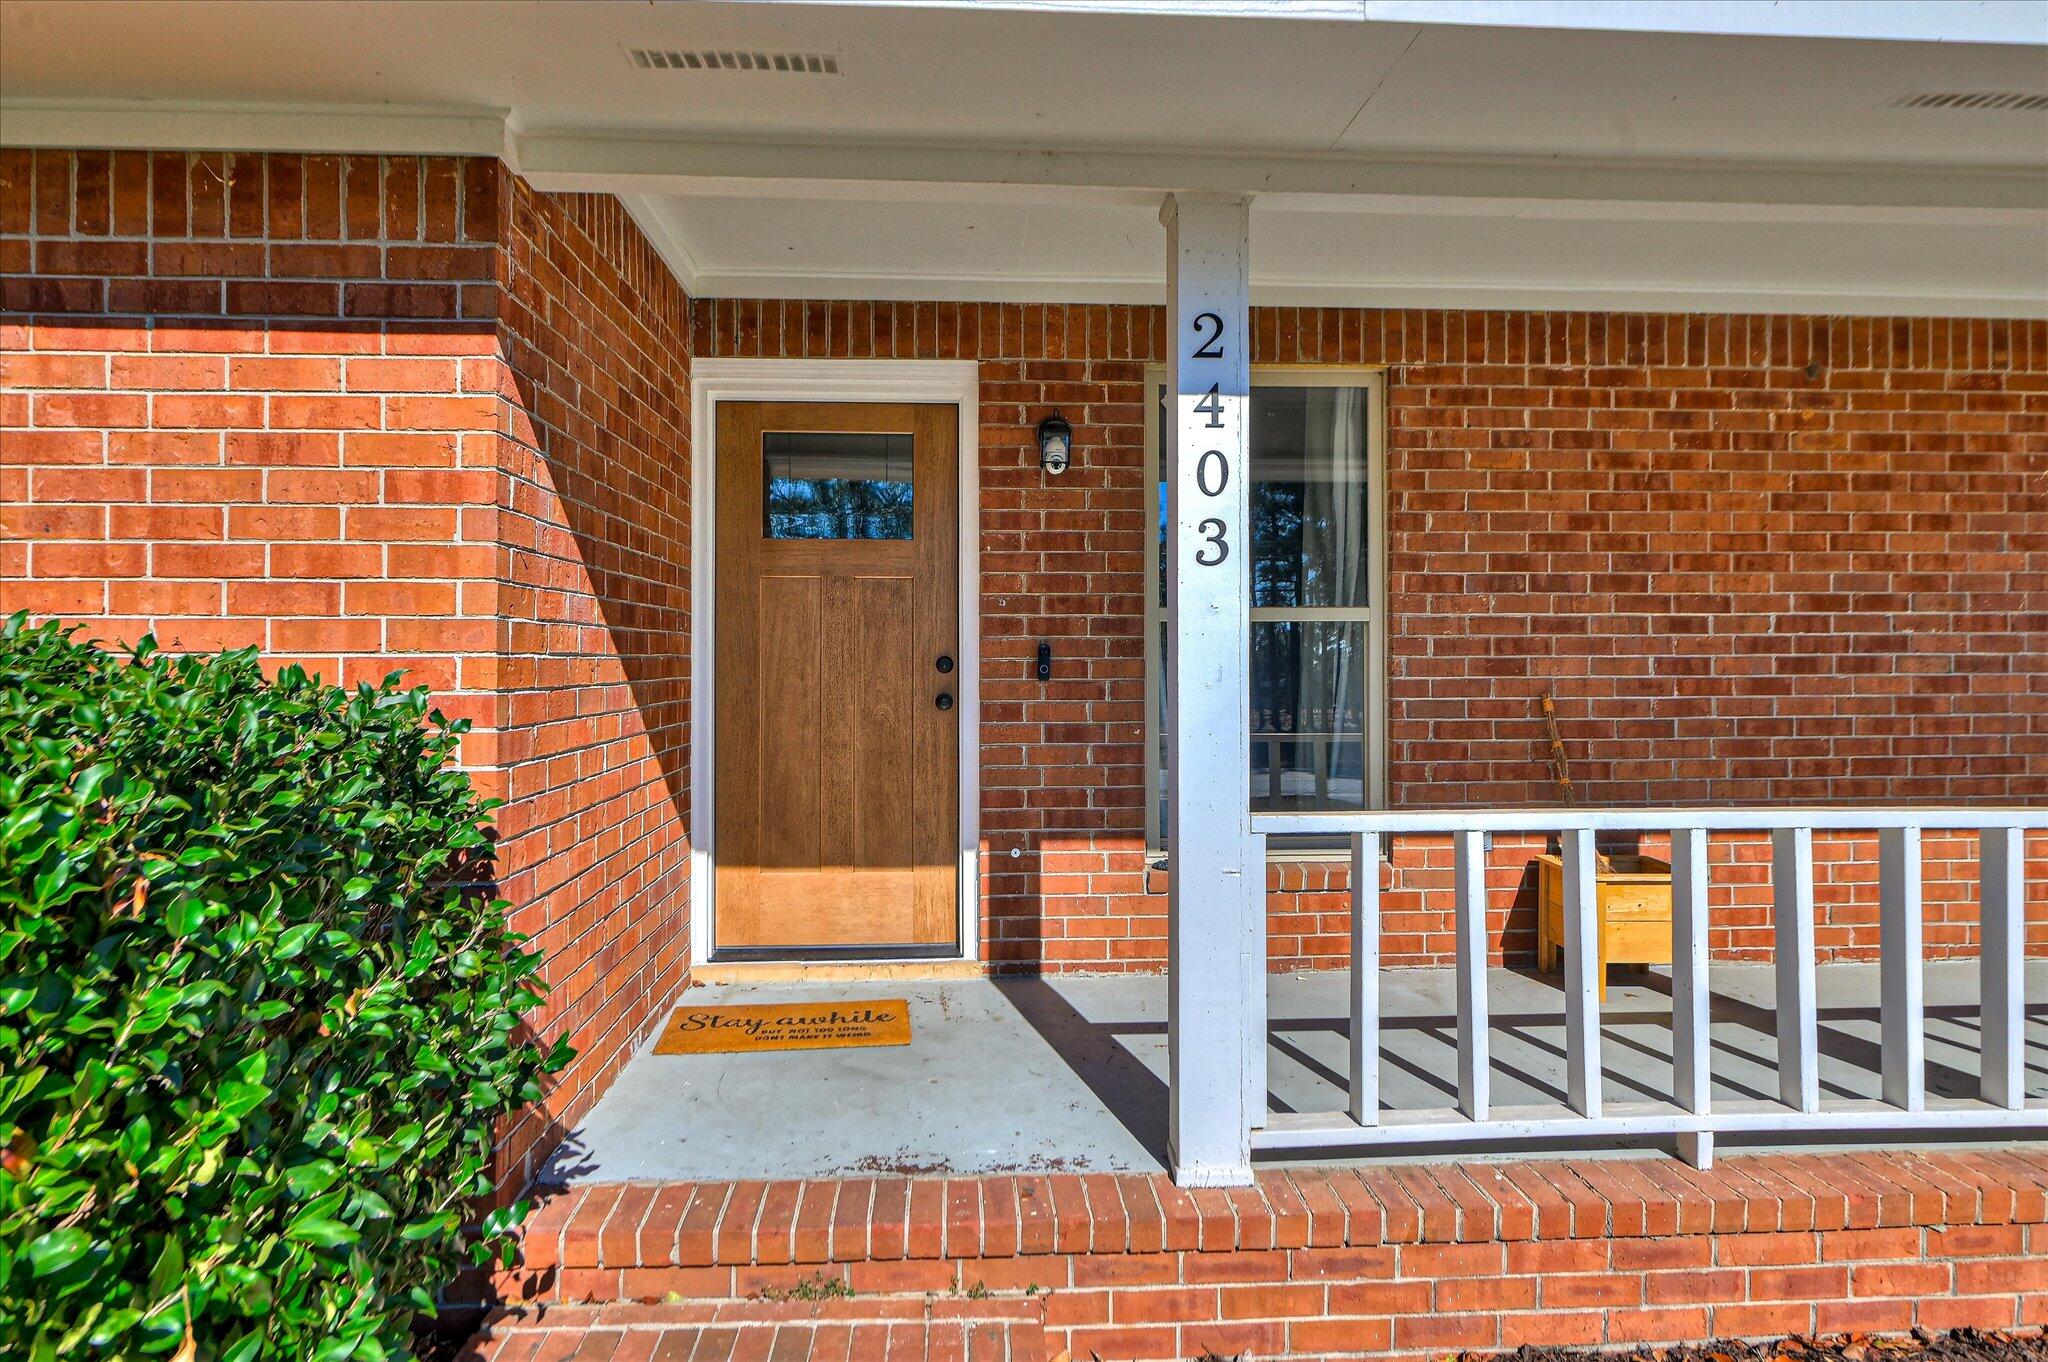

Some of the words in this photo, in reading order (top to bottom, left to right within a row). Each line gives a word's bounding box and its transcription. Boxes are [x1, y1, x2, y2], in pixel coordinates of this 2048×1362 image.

[1191, 312, 1230, 567] 2403
[679, 1013, 770, 1035] Stay
[776, 1010, 896, 1026] awhile
